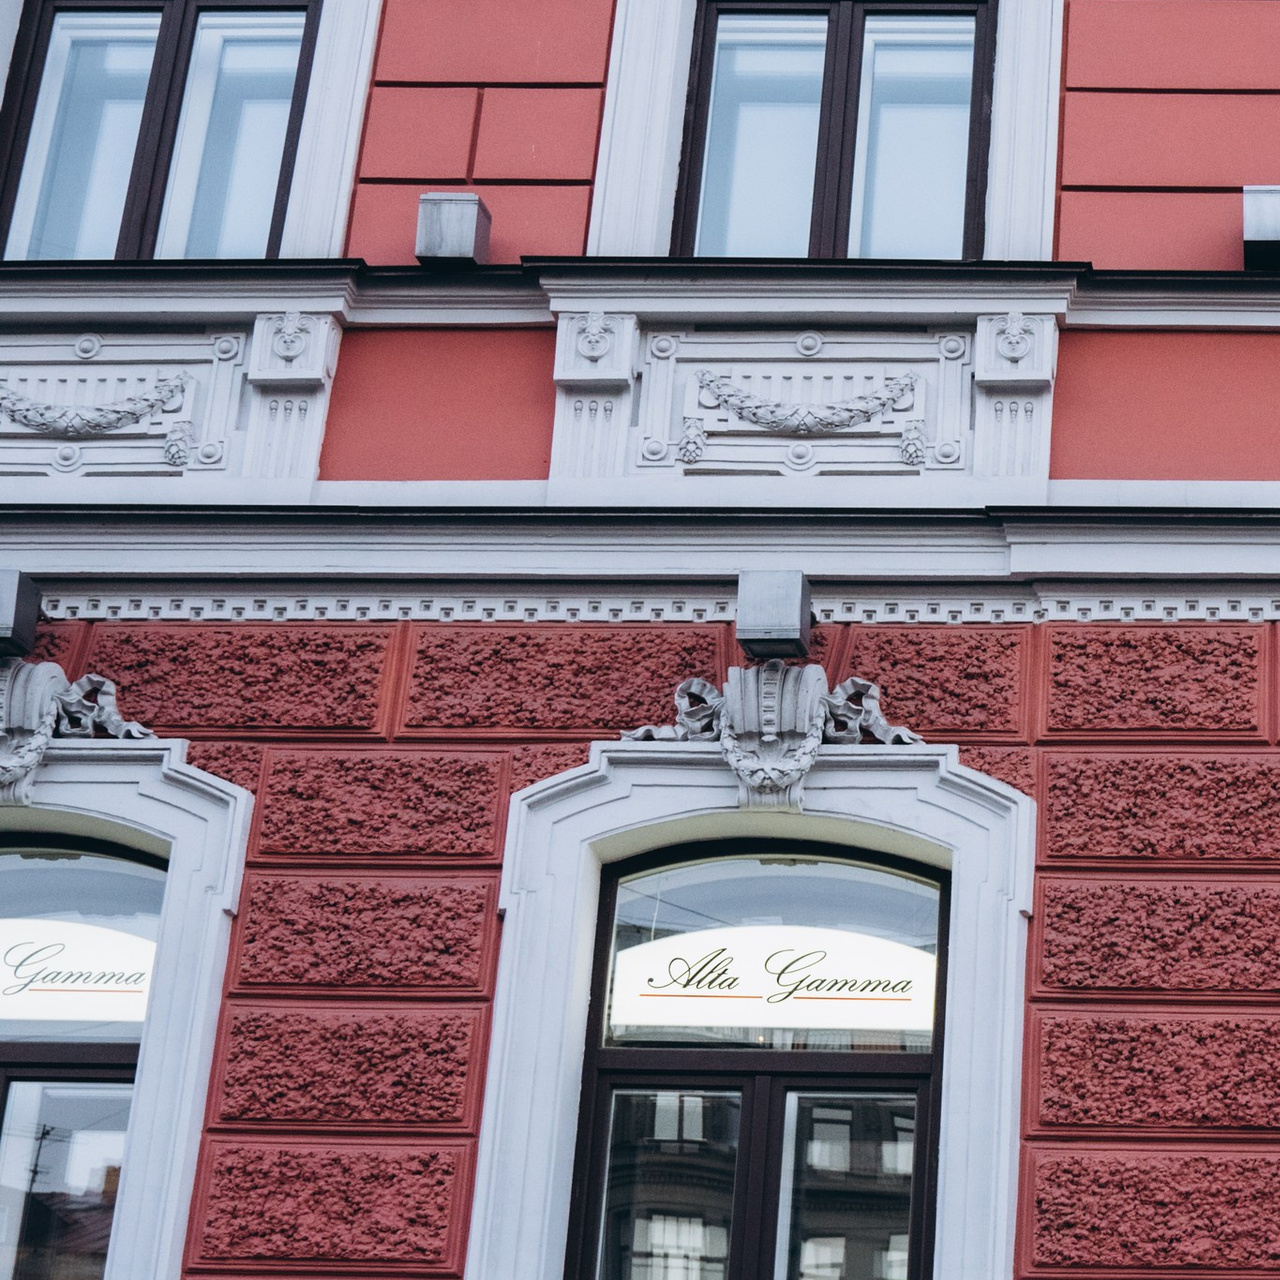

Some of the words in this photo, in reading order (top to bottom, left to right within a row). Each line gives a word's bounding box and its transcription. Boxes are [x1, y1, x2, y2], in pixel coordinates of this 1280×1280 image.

[2, 941, 146, 996] Gamma
[647, 947, 740, 990] Alta
[764, 948, 913, 1004] Gamma
